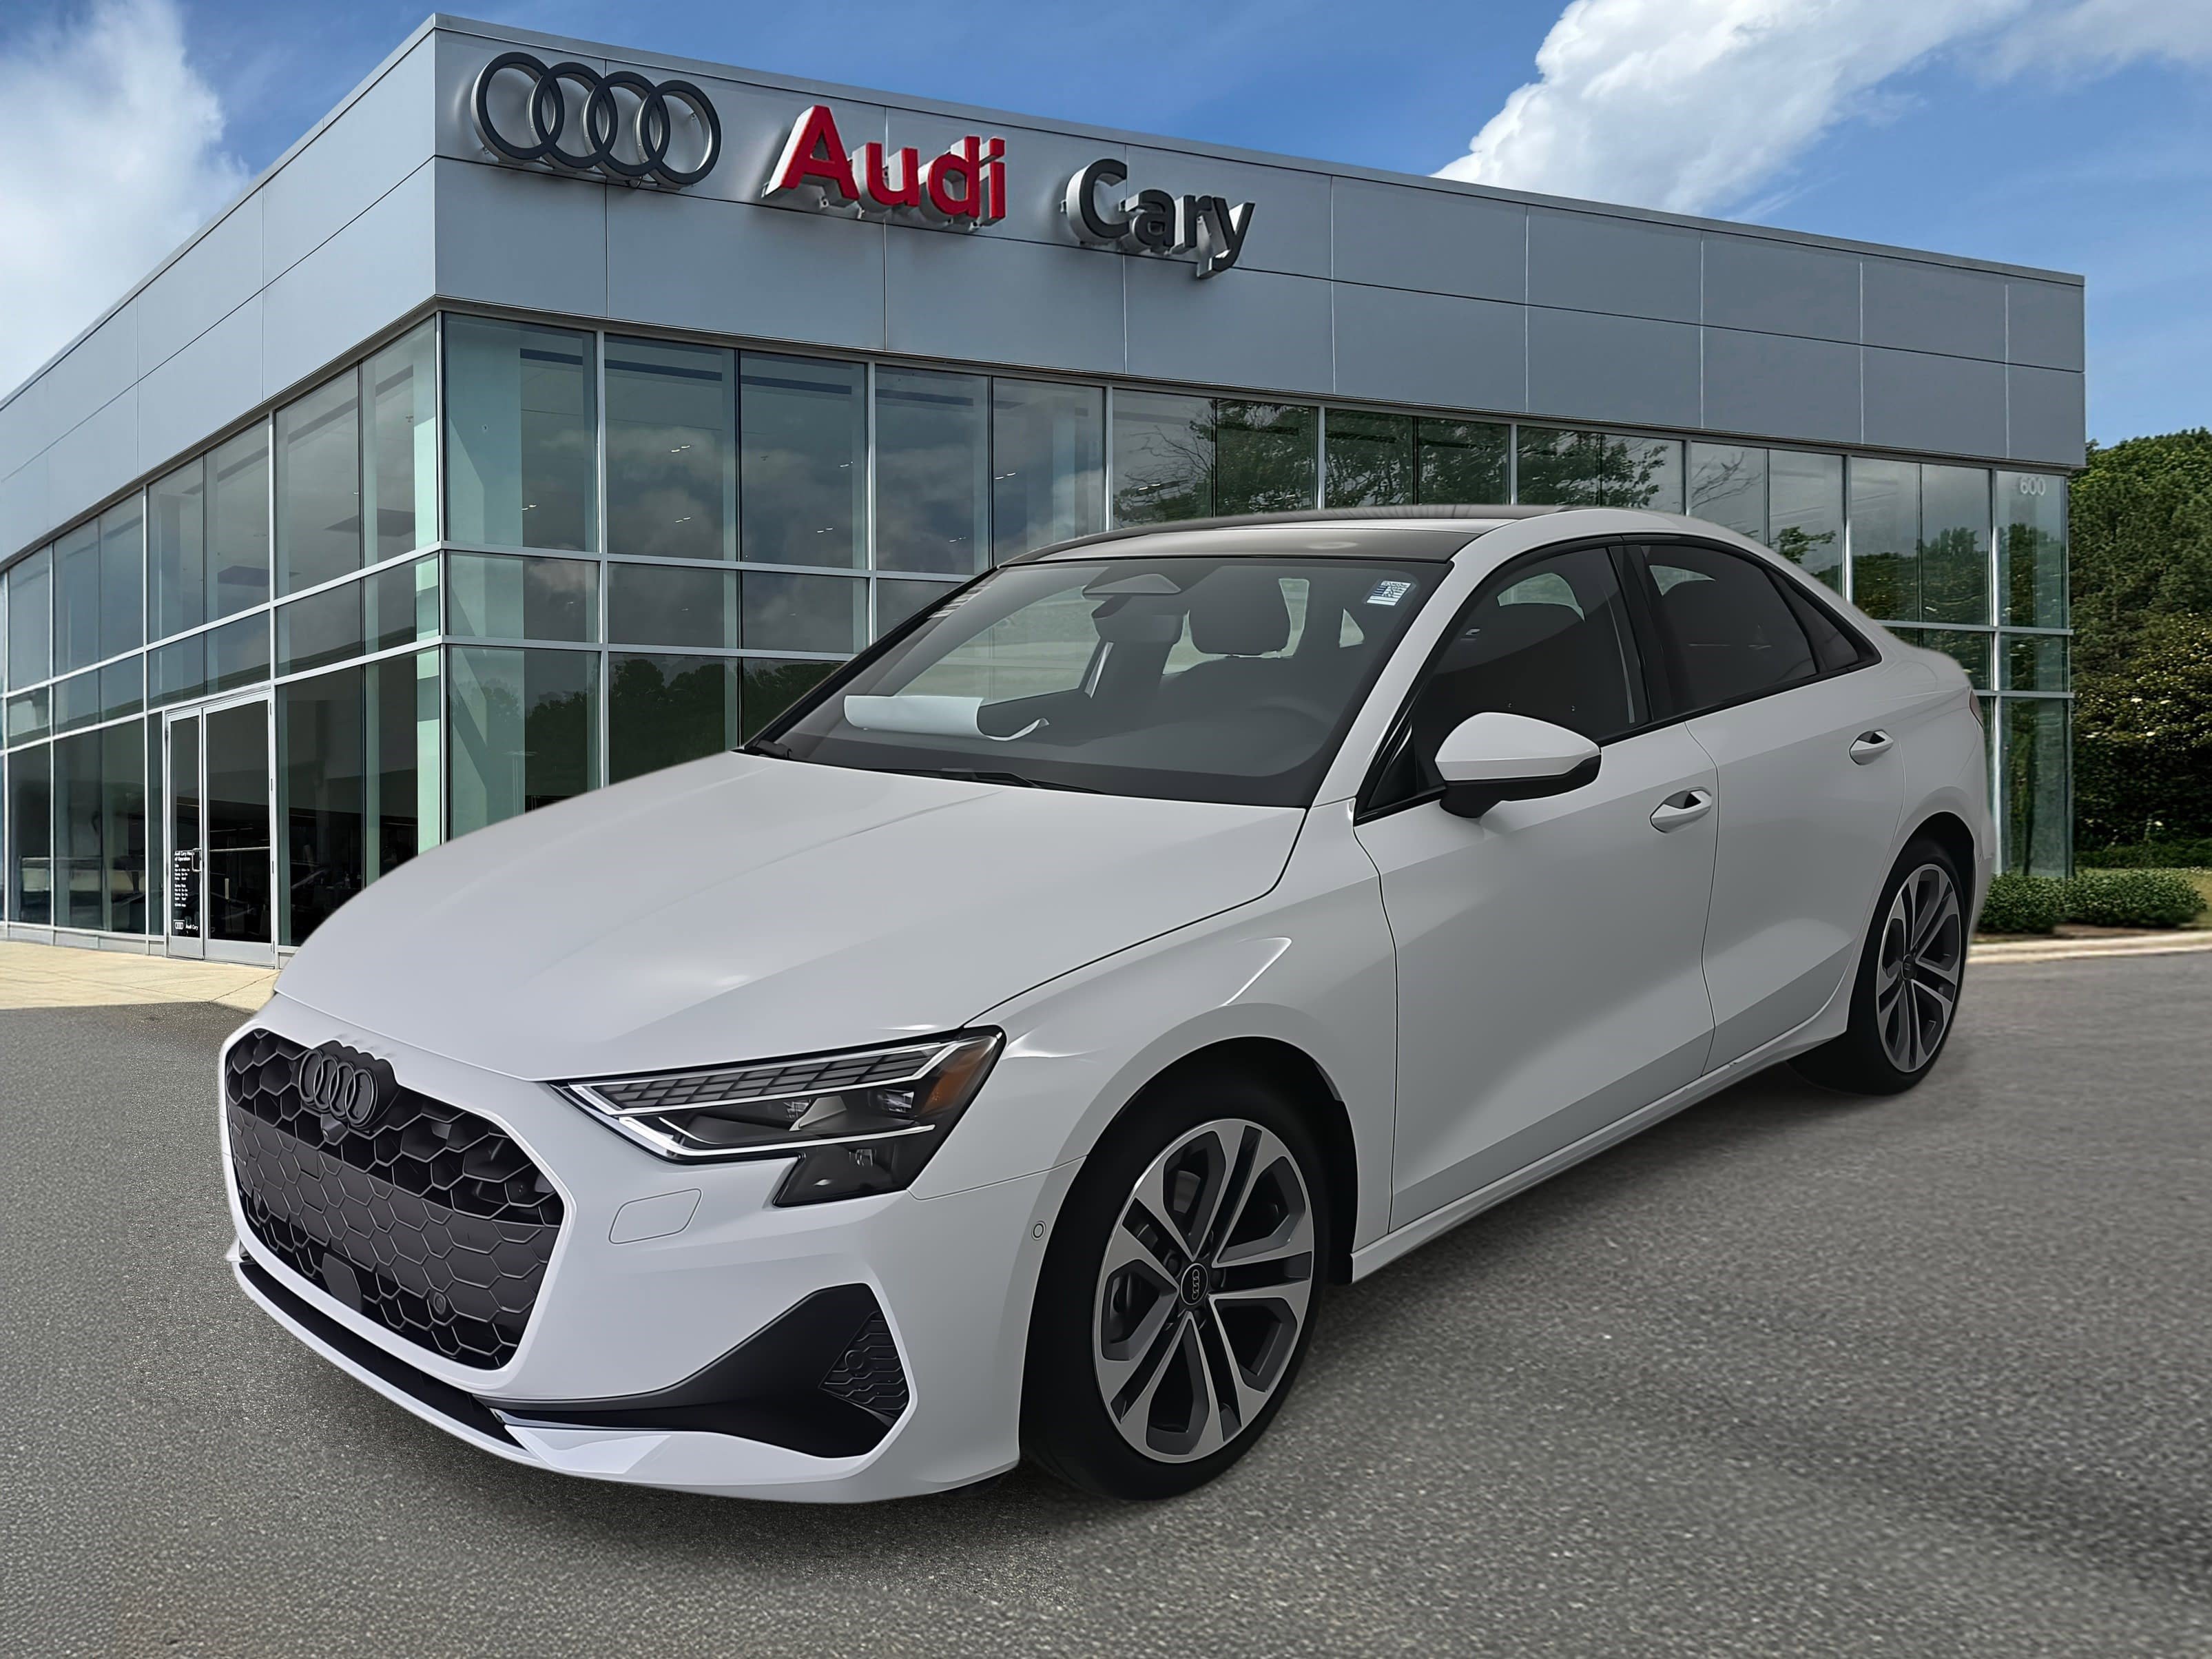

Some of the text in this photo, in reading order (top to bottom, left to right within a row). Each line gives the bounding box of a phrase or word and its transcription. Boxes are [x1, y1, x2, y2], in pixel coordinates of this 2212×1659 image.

[765, 105, 1255, 277] Audi Cary
[2020, 476, 2046, 496] 600
